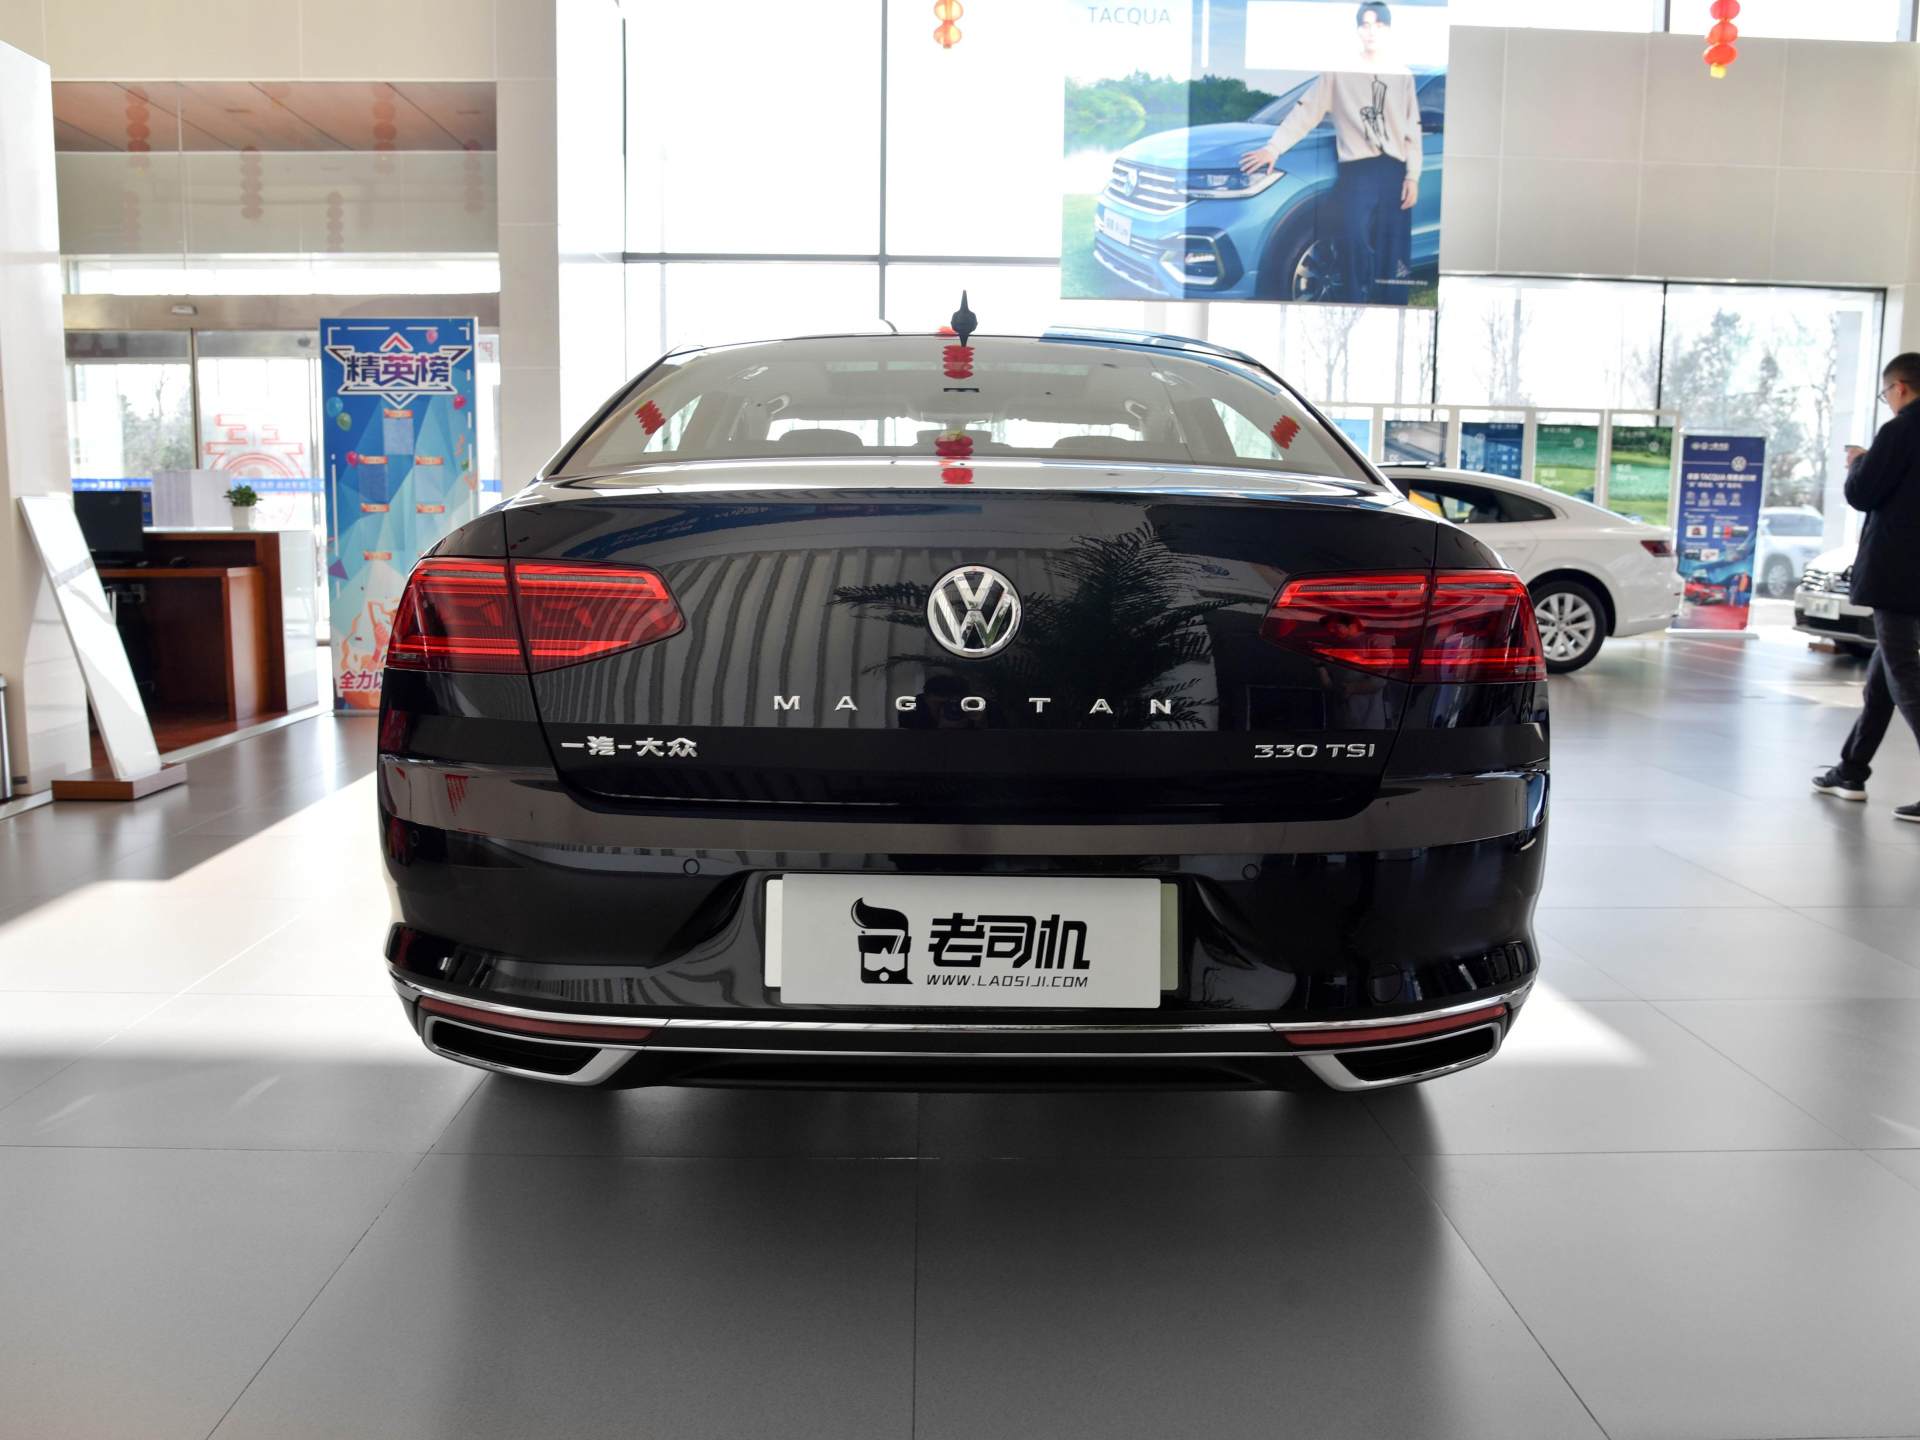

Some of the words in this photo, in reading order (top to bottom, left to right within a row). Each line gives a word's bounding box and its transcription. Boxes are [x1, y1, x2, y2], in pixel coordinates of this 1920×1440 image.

[1087, 6, 1172, 26] TACQUA
[345, 353, 451, 387] 精英榜
[772, 695, 1173, 716] MAGOTAN
[561, 736, 698, 758] 一汽-大众
[1254, 743, 1318, 759] 330
[1326, 743, 1375, 758] TSI
[927, 911, 1091, 970] 老司机
[926, 973, 1089, 988] WWW.LAOSIJI.COM
